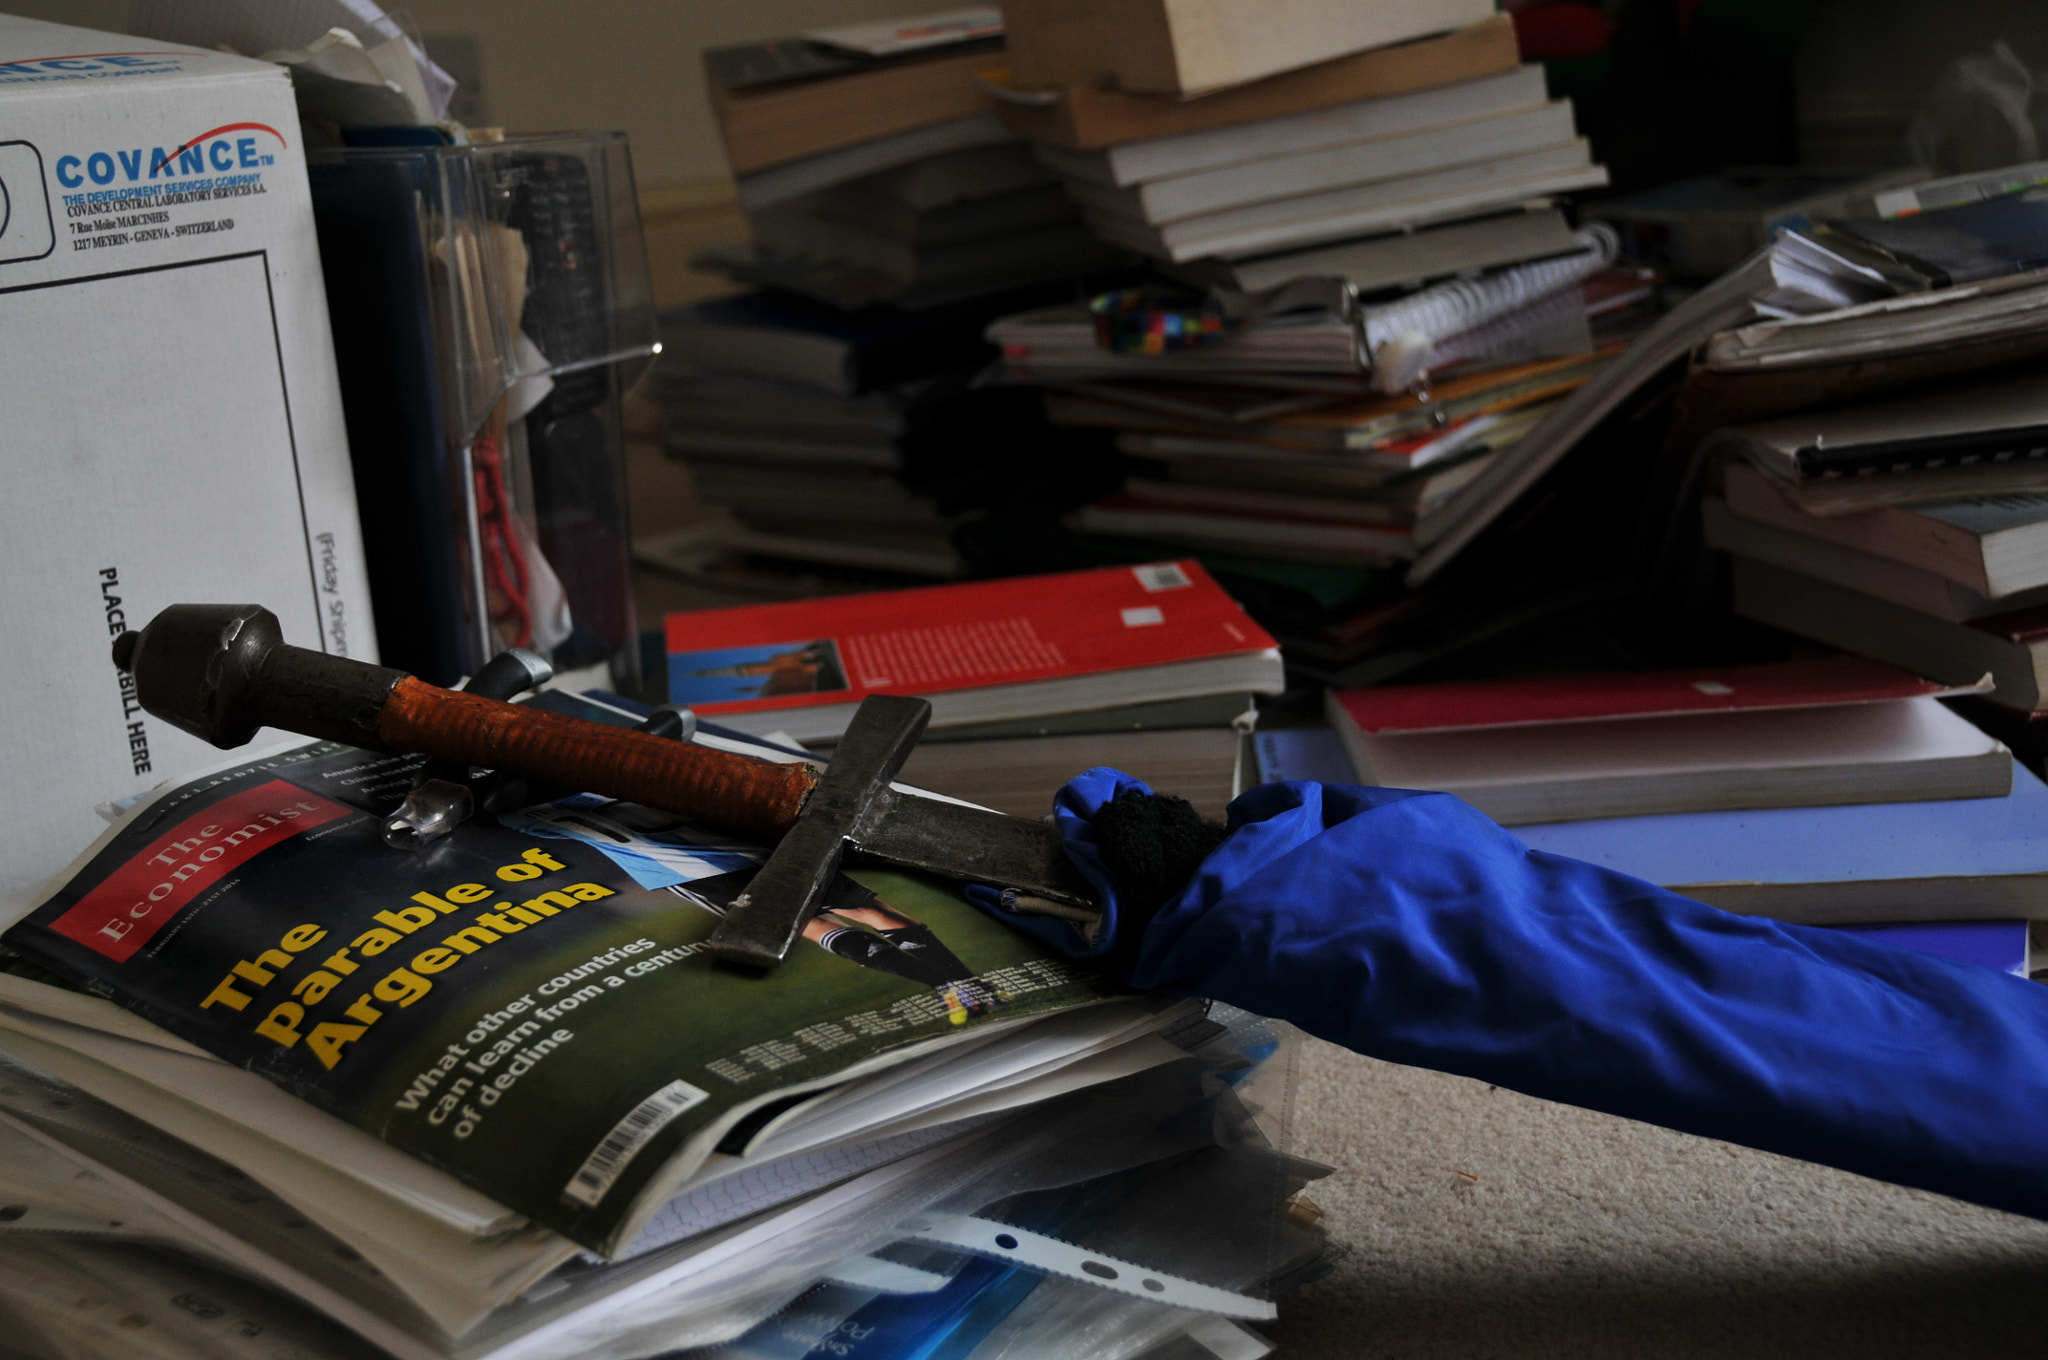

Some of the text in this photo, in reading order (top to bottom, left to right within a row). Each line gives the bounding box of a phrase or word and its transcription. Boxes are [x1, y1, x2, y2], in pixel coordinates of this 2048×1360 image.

[56, 138, 260, 189] COVANCE
[62, 173, 261, 207] THE DEVELOPMENT SERVICES COMPANY
[67, 202, 113, 218] COVANCE
[112, 195, 154, 213] CENTRAL
[155, 189, 213, 208] LABORATORY
[213, 185, 254, 201] SERVICES
[73, 238, 92, 250] 1217
[92, 231, 129, 248] MEYRIN
[134, 227, 170, 243] GENEVA
[175, 219, 234, 238] SWITZERLAND
[77, 222, 94, 234] Rue
[117, 211, 170, 227] MARCINHES
[99, 566, 127, 636] PLACE
[127, 721, 151, 775] HERE
[98, 800, 320, 943] Economist
[146, 822, 223, 869] The
[220, 878, 241, 893] 2014
[200, 923, 328, 1012] The
[254, 847, 567, 1049] parable of
[305, 881, 616, 1071] Argentina
[396, 937, 656, 1112] What other countries
[427, 1076, 475, 1126] can
[465, 1019, 542, 1075] learn
[534, 983, 605, 1023] from
[602, 974, 626, 988] a
[453, 1027, 575, 1139] of decline
